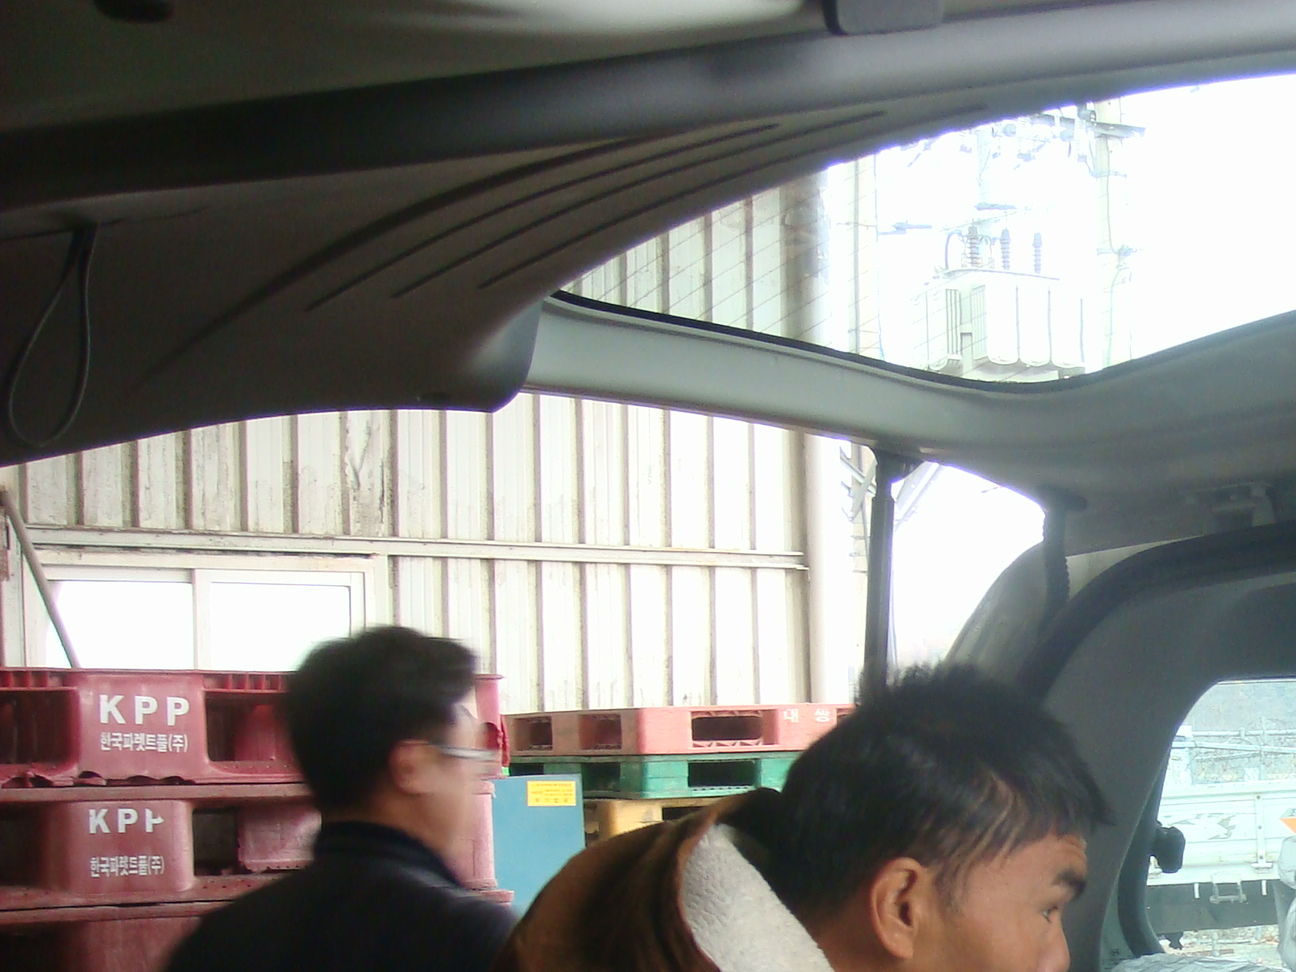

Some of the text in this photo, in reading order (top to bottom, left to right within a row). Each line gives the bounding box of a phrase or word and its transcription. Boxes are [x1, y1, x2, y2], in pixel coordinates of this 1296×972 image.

[99, 694, 190, 726] KPP
[100, 732, 188, 753] 한국파렛트풀(주)
[90, 856, 165, 878] 한국파렛트풀(주)
